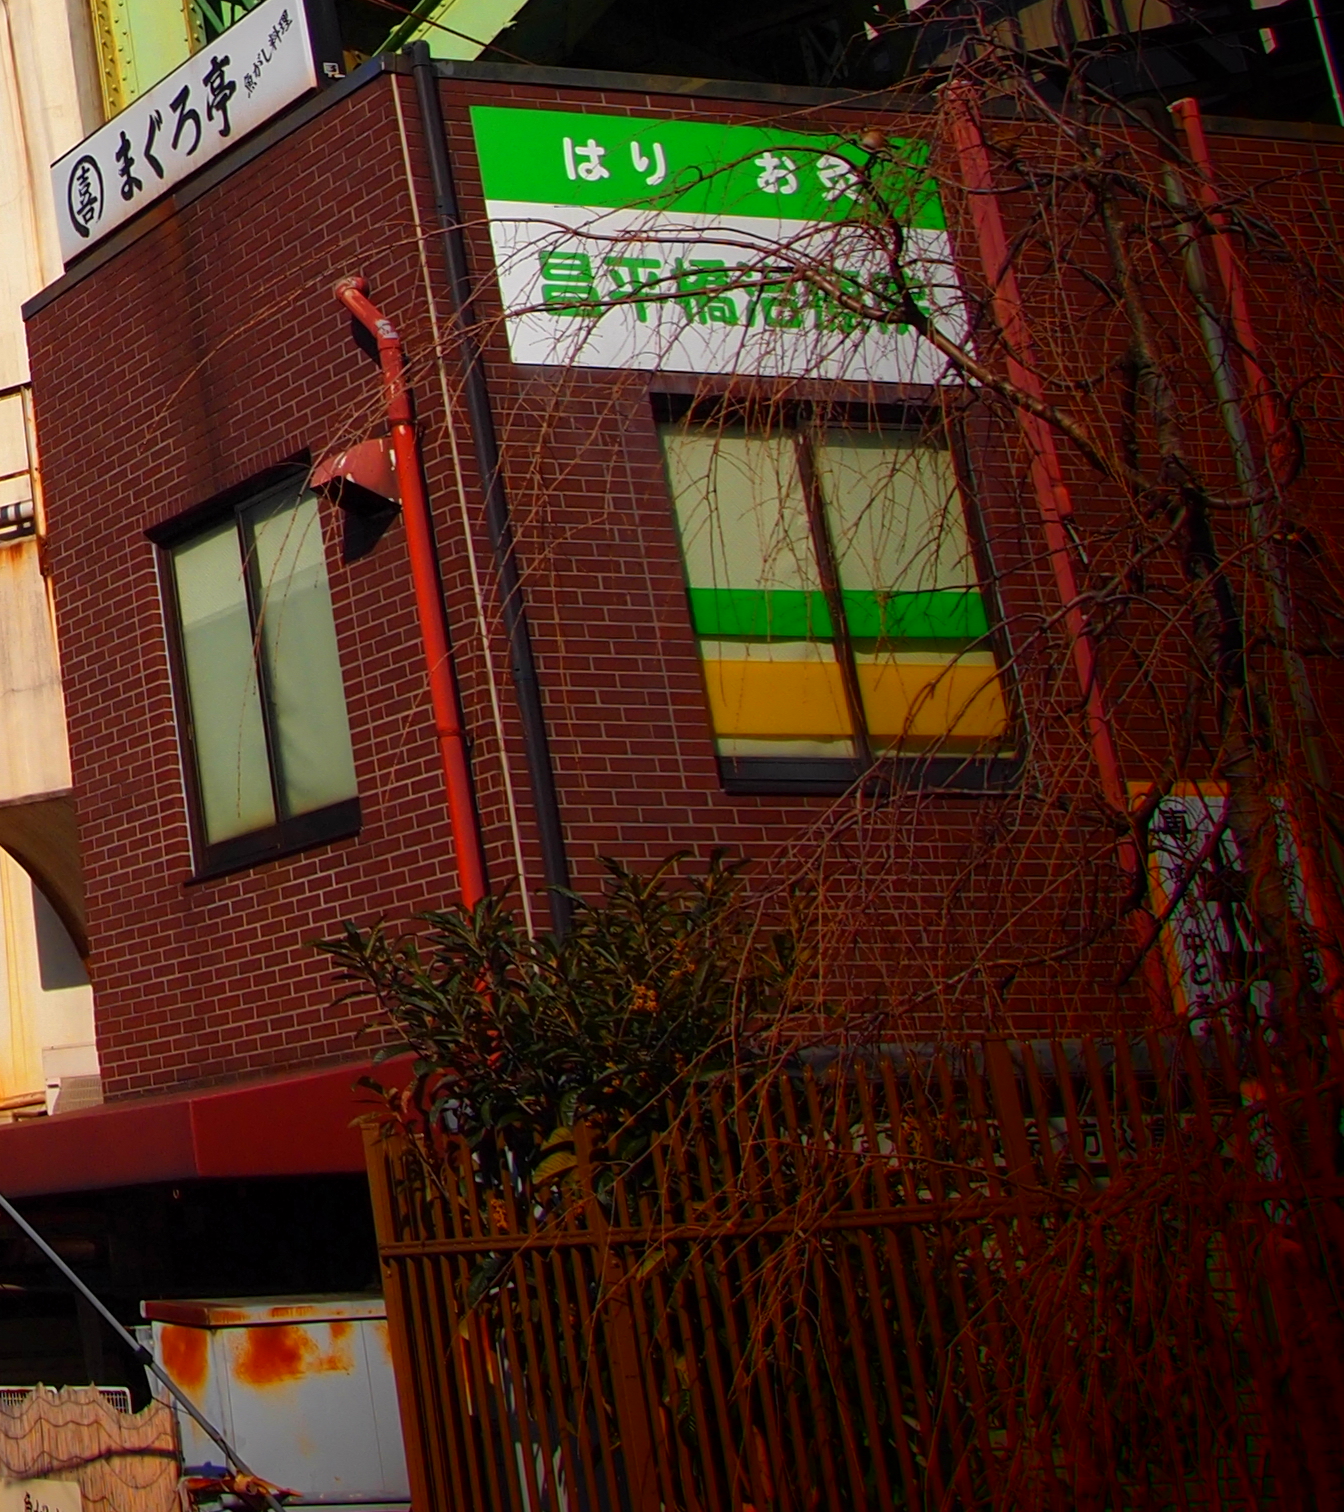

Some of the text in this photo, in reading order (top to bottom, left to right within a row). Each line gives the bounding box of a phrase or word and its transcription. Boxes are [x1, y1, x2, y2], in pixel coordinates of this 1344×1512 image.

[243, 8, 293, 99] 魚がし料理
[115, 55, 237, 202] まぐろ亭
